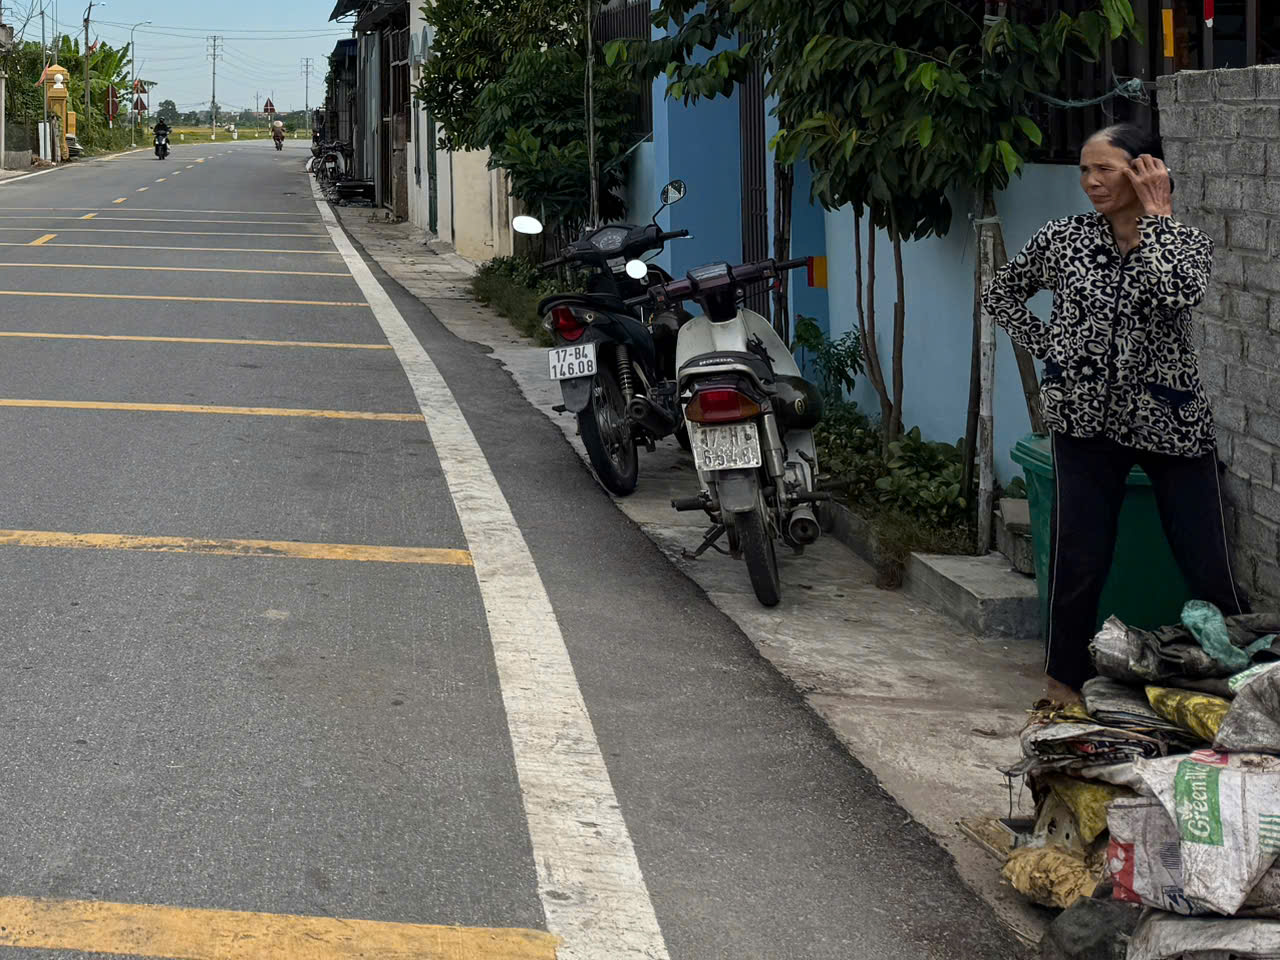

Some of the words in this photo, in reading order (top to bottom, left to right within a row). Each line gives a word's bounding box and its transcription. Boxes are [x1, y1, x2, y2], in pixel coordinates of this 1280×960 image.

[555, 346, 588, 363] 17-B4
[552, 360, 593, 378] 146.08
[1186, 781, 1211, 838] Green
